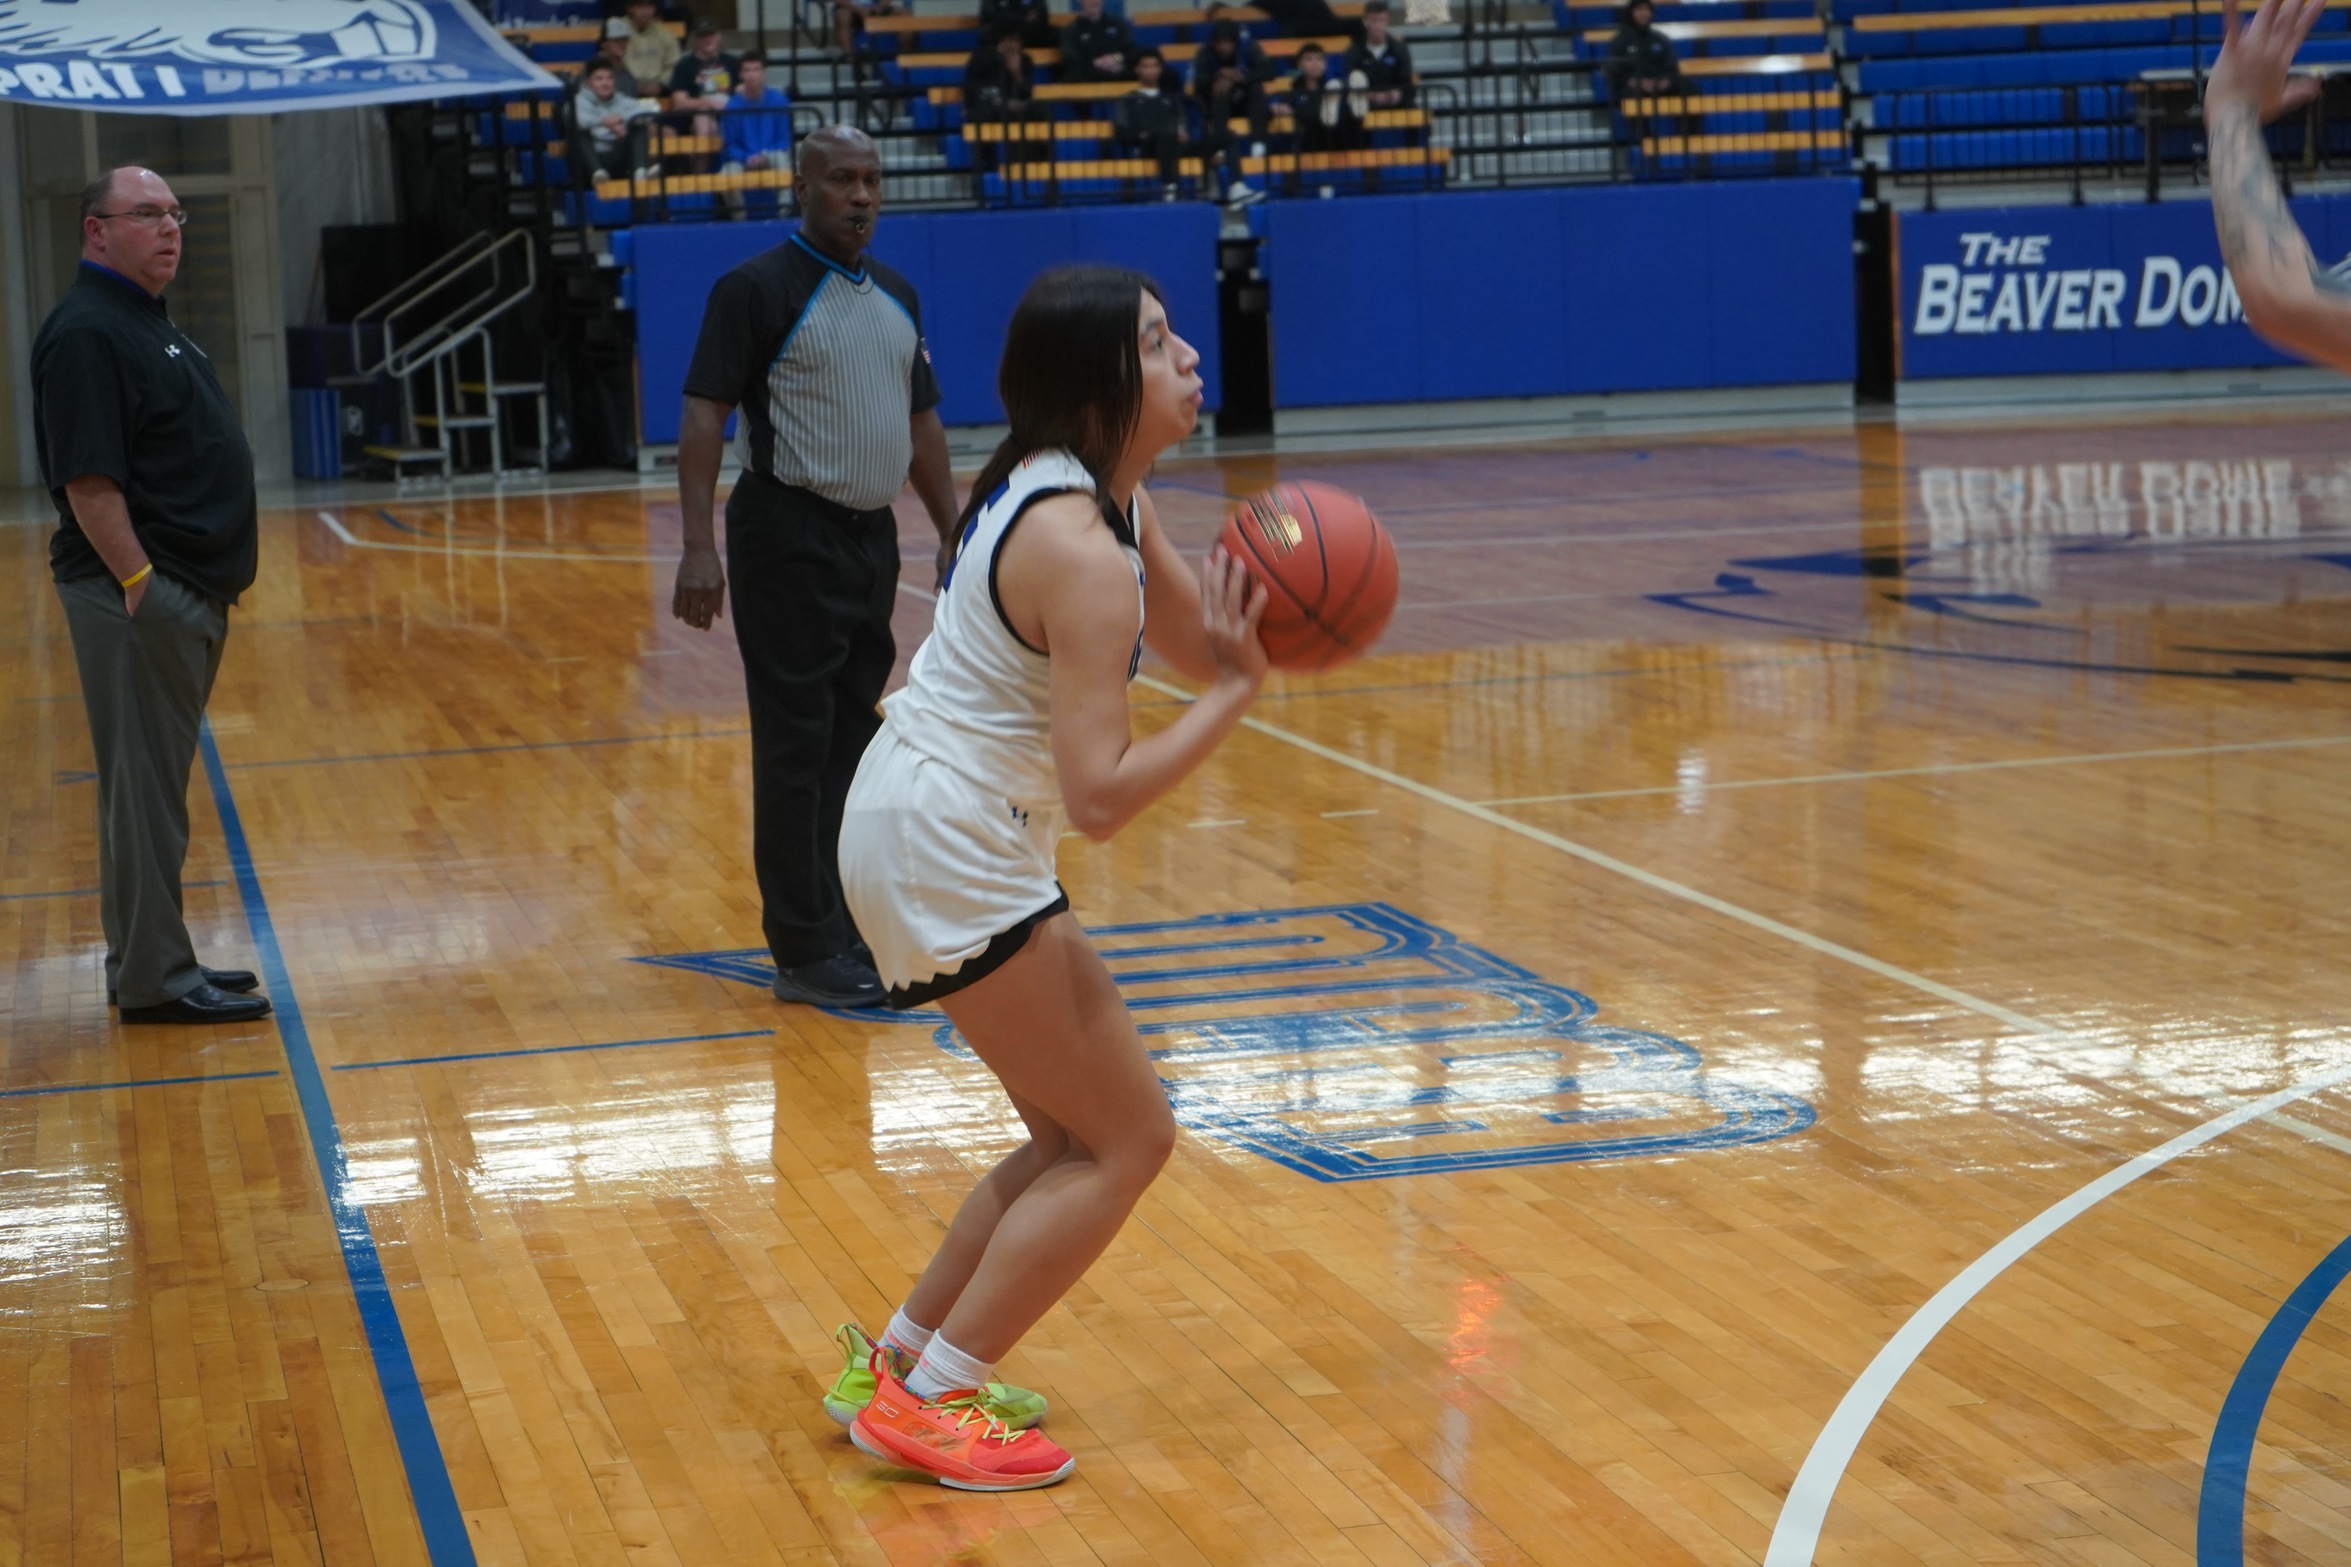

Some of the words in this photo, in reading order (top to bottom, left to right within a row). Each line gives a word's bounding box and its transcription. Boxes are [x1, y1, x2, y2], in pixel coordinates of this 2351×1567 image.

[1960, 232, 2052, 267] THE
[1914, 264, 2127, 334] BEAVER
[2135, 256, 2248, 328] DOM
